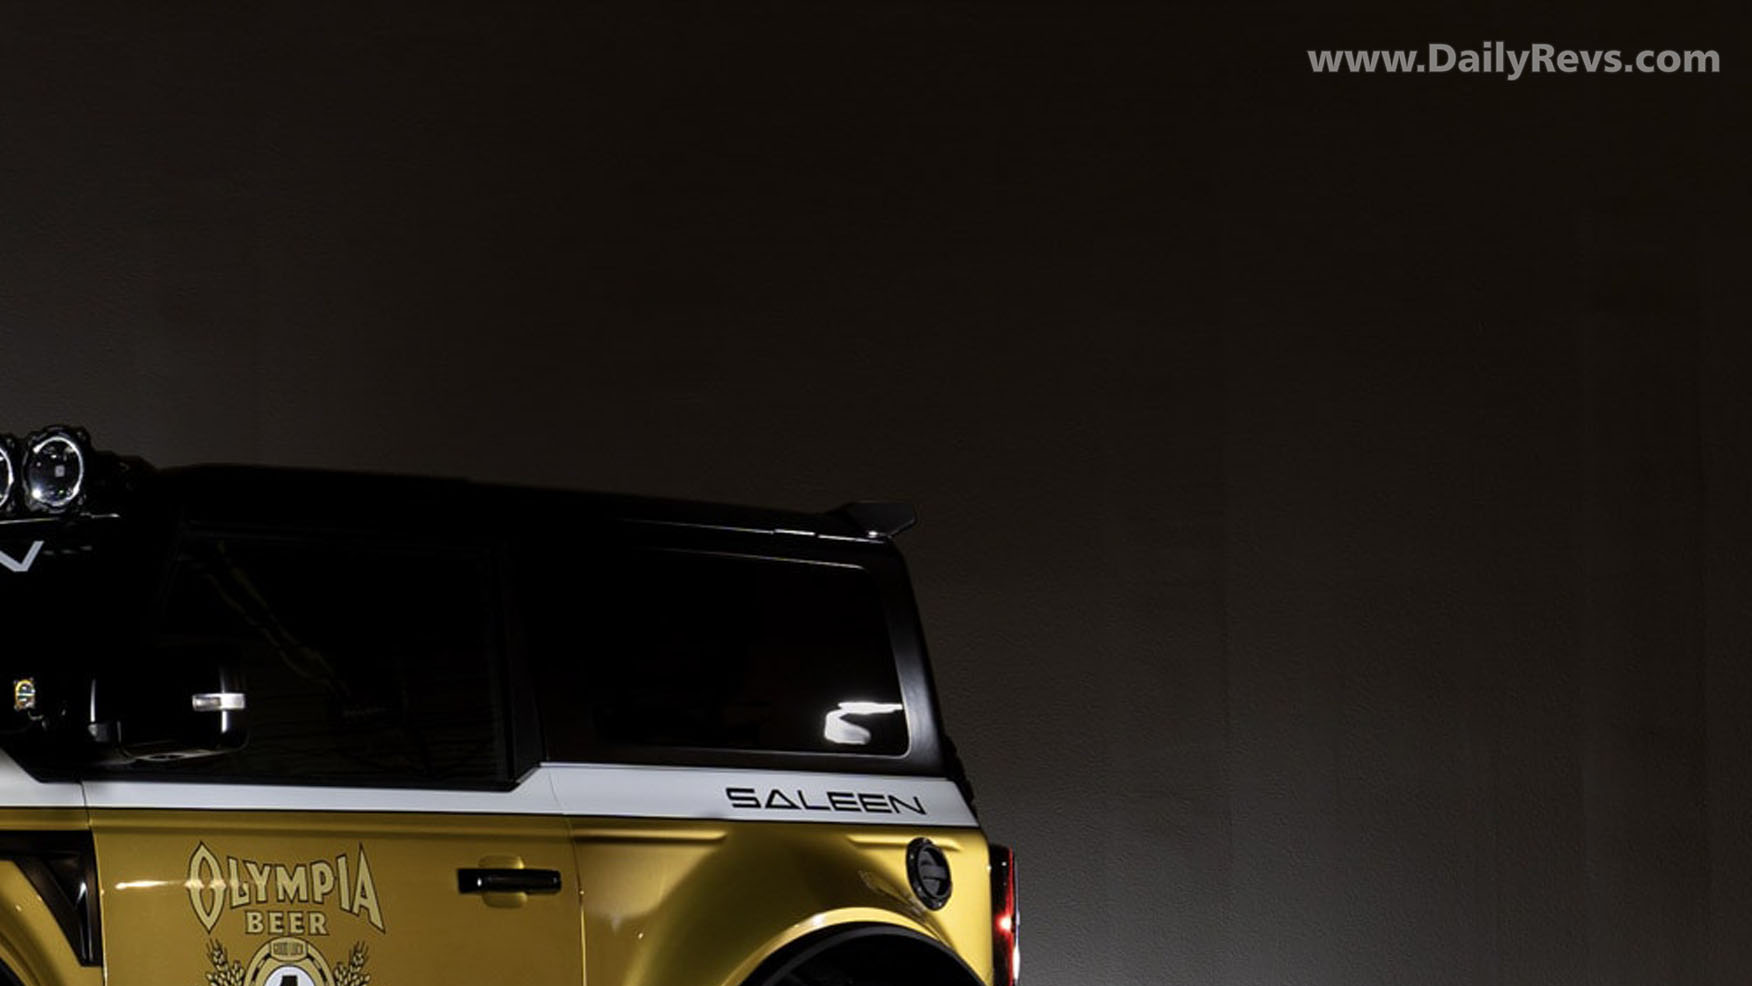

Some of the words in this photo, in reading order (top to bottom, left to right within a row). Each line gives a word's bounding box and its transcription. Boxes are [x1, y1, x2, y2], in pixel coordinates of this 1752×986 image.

[725, 786, 927, 815] SALEEN
[186, 841, 386, 935] OLYMPIA
[245, 910, 330, 936] BEER
